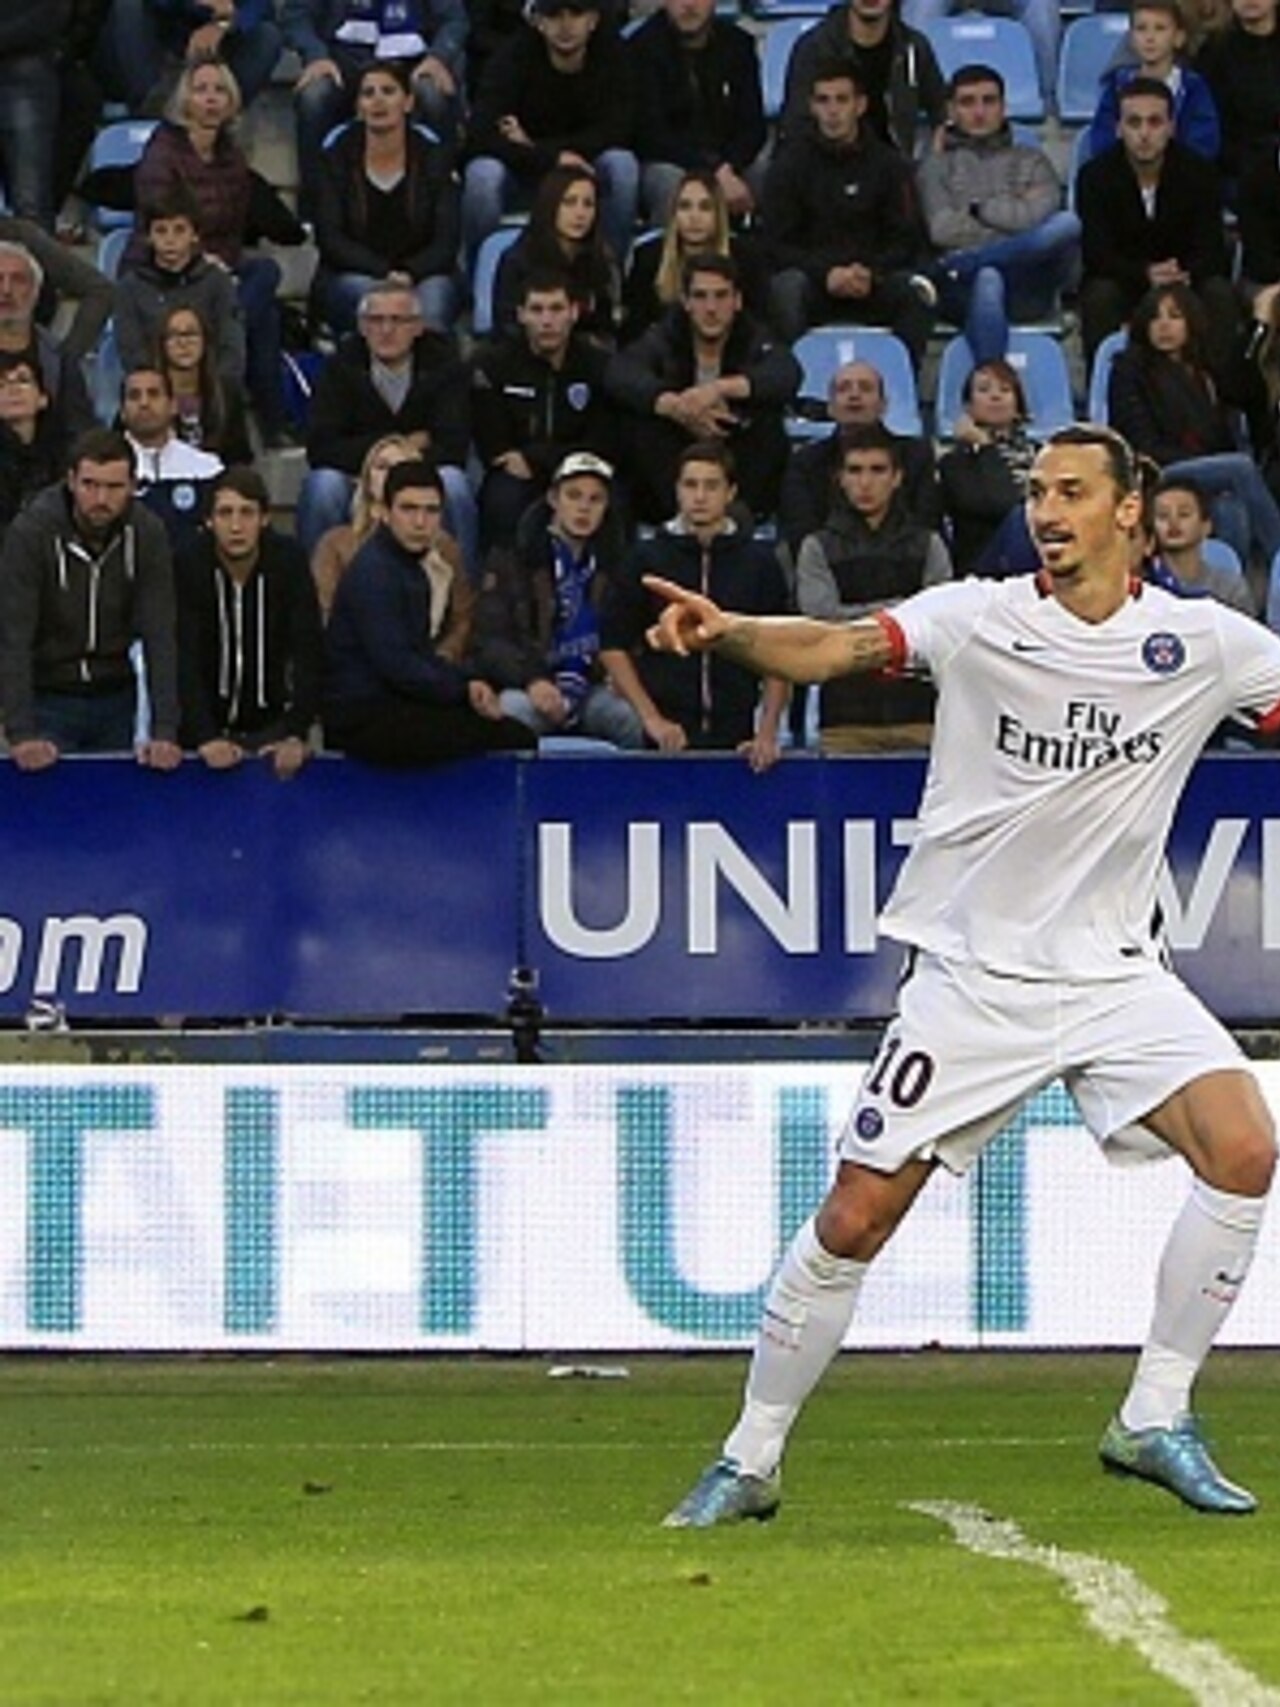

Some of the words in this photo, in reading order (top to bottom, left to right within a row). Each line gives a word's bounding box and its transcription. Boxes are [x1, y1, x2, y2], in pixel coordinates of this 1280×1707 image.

[1066, 701, 1122, 738] Fly
[538, 816, 918, 958] UNI
[867, 1038, 935, 1109] 10
